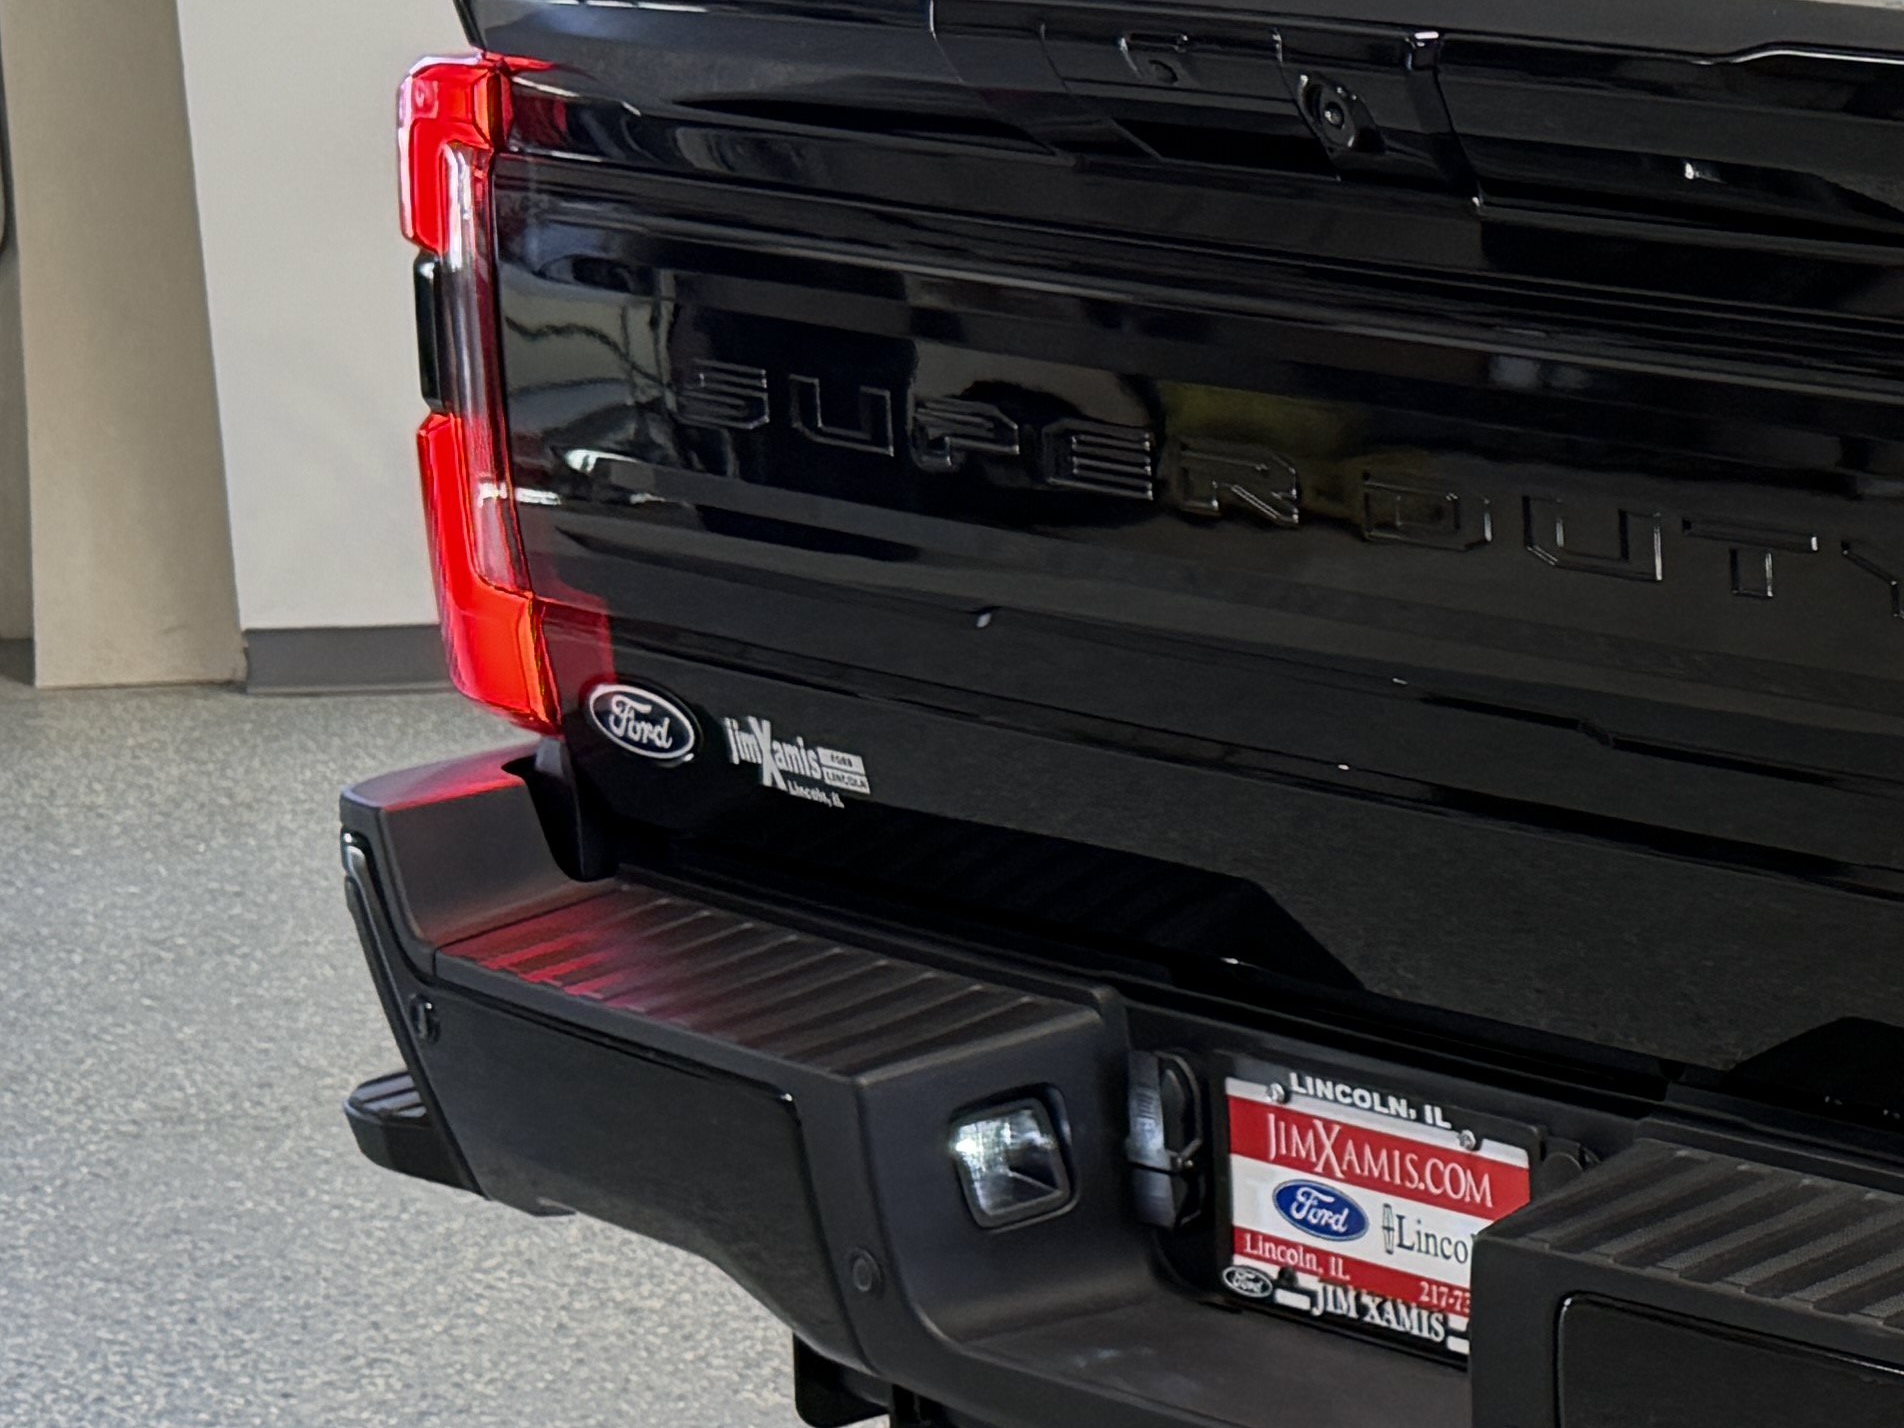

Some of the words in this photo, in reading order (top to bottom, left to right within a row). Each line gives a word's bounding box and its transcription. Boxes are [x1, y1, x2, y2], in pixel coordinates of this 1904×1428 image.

[674, 360, 1303, 526] SUPER
[608, 694, 673, 750] Ford
[1288, 1072, 1418, 1121] LINCOLN,
[1424, 1104, 1452, 1129] IL
[1291, 1186, 1350, 1234] Ford
[1397, 1213, 1473, 1265] Linco
[1311, 1282, 1359, 1320] JIM
[1360, 1289, 1446, 1343] XAMIS
